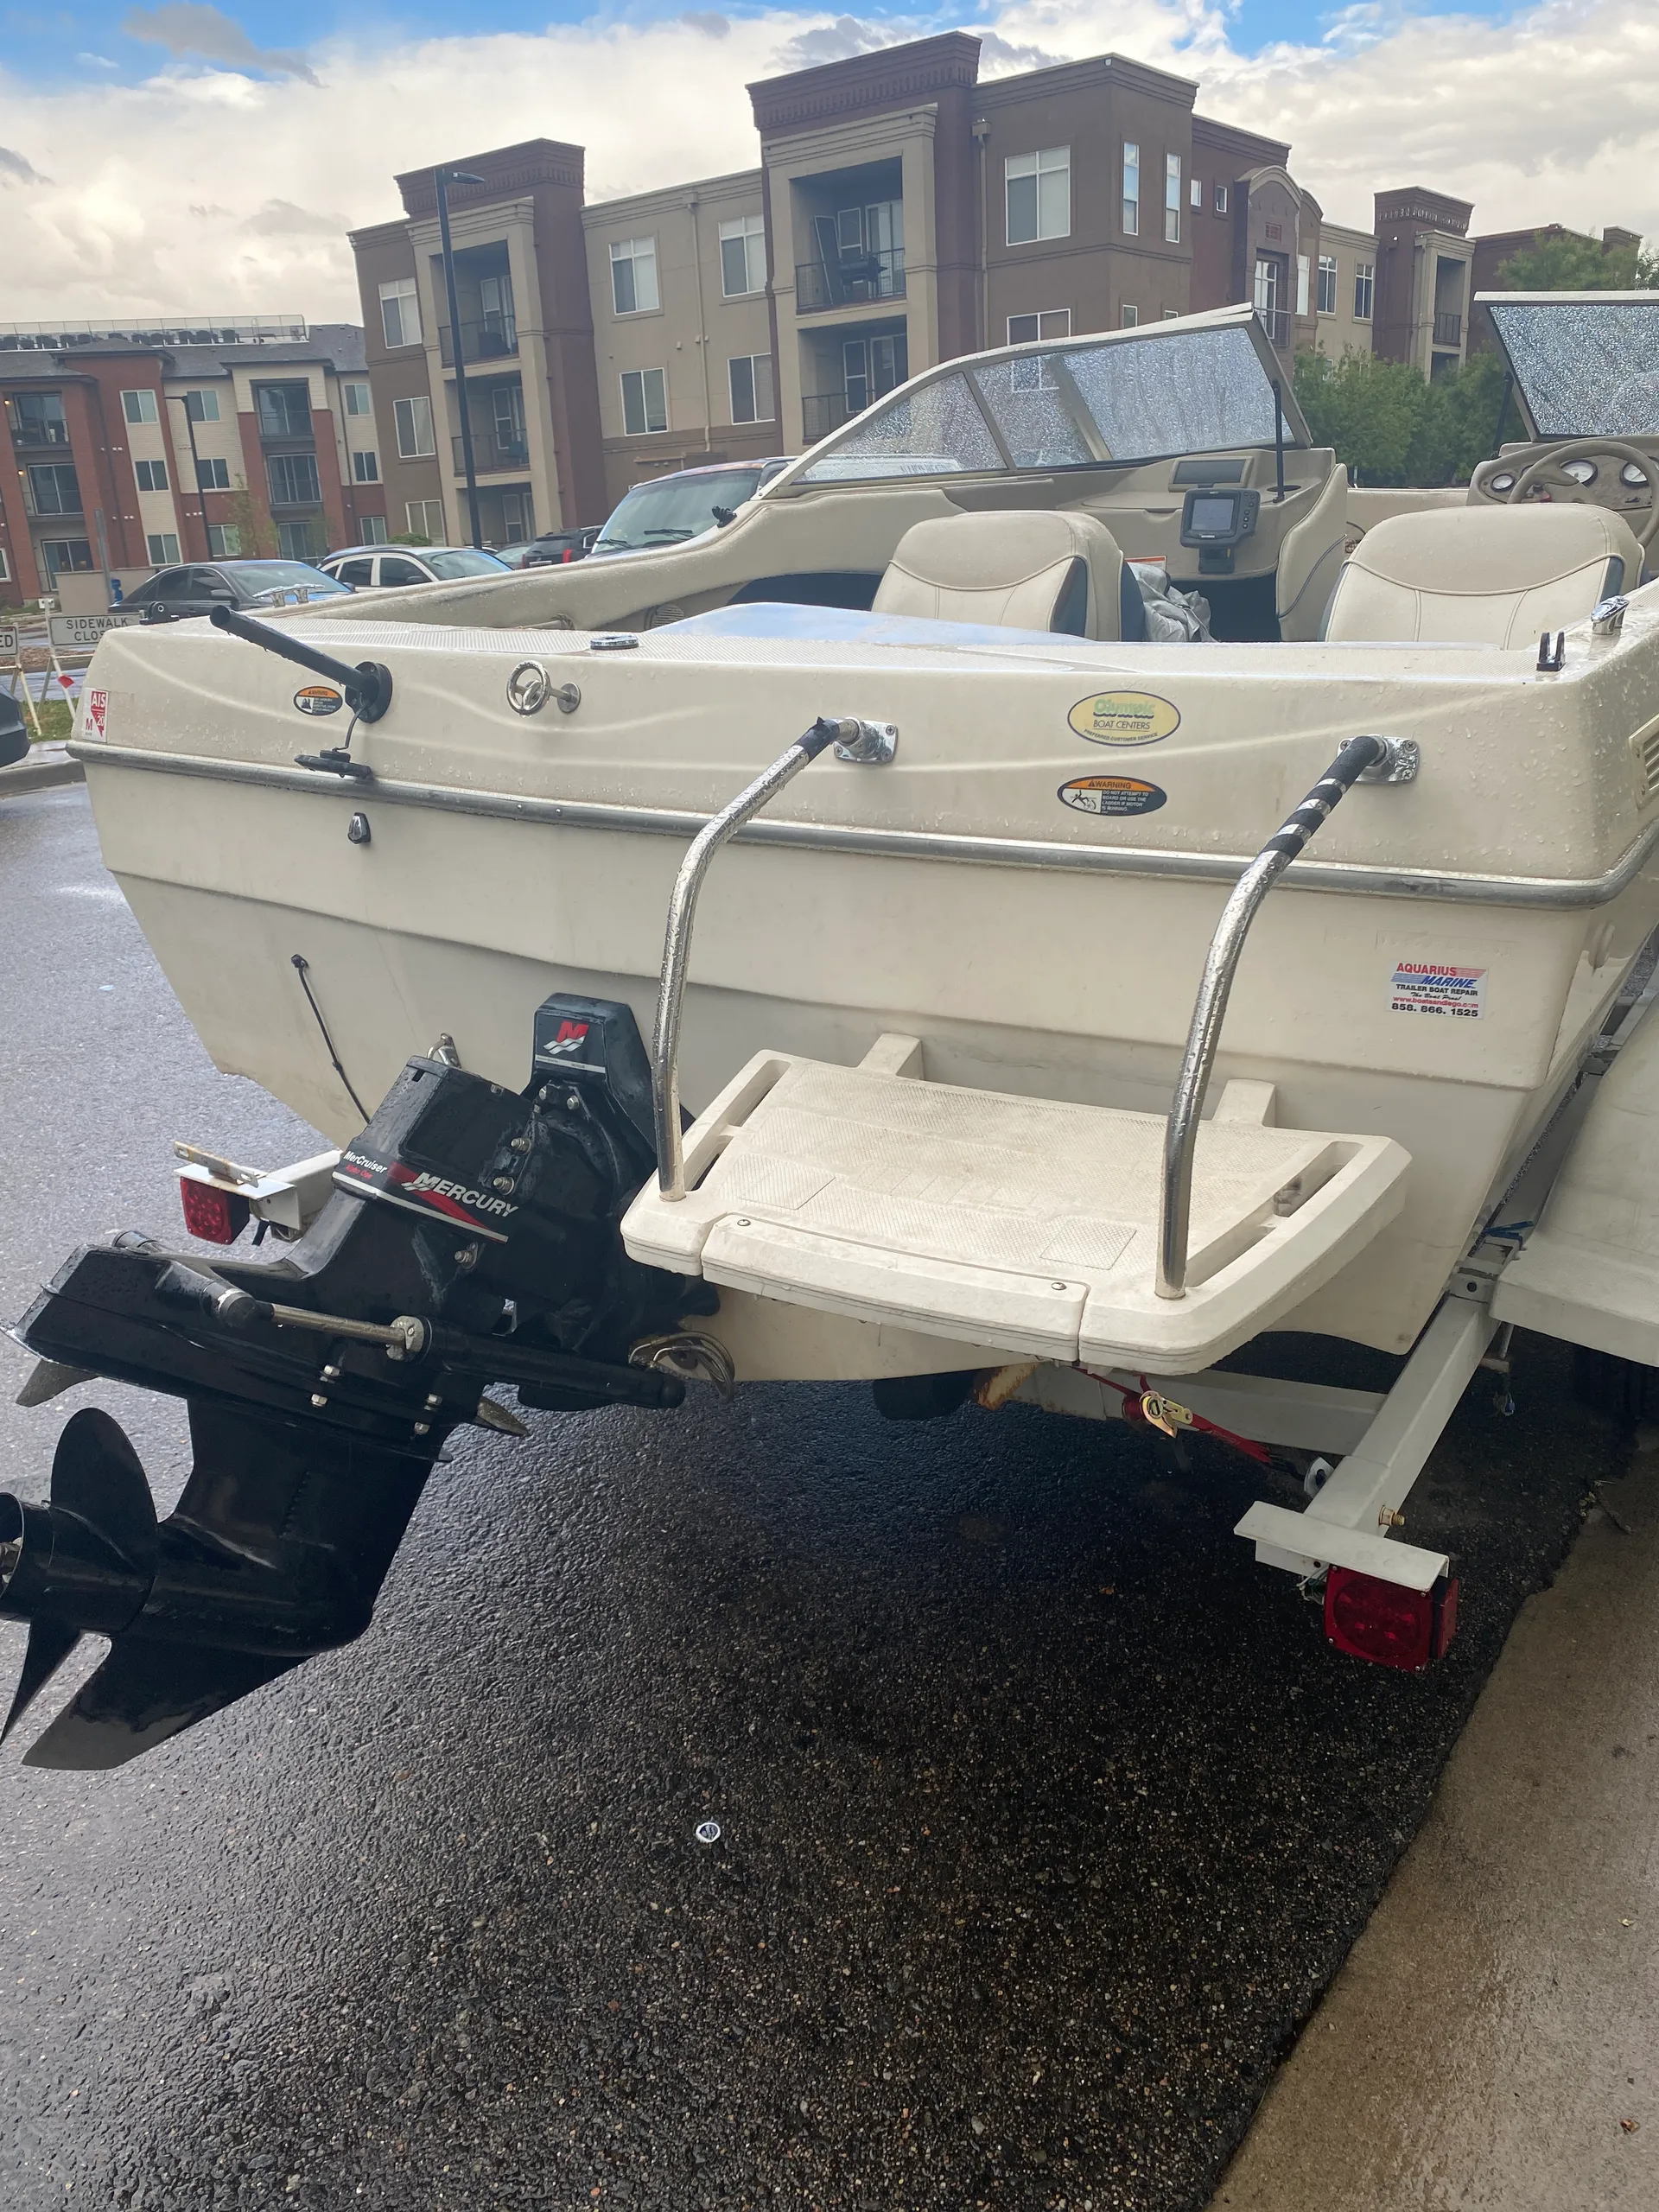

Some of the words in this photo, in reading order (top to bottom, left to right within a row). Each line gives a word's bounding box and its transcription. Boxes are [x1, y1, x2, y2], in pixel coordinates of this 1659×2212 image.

[67, 618, 128, 630] SIDEWALK
[92, 693, 105, 708] AIS
[1093, 720, 1115, 728] BOAT
[1116, 720, 1150, 730] CENTERS
[1084, 728, 1109, 741] PREFERRED
[1137, 732, 1158, 741] SERVICE
[1095, 780, 1132, 789] WARNING
[1396, 963, 1458, 976] AQUARIUS
[1391, 1003, 1417, 1012] 858.
[1421, 1005, 1446, 1014] 866.
[1451, 1008, 1478, 1017] 1525
[343, 1150, 388, 1173] MerCruiser
[412, 1172, 518, 1217] MERCURY
